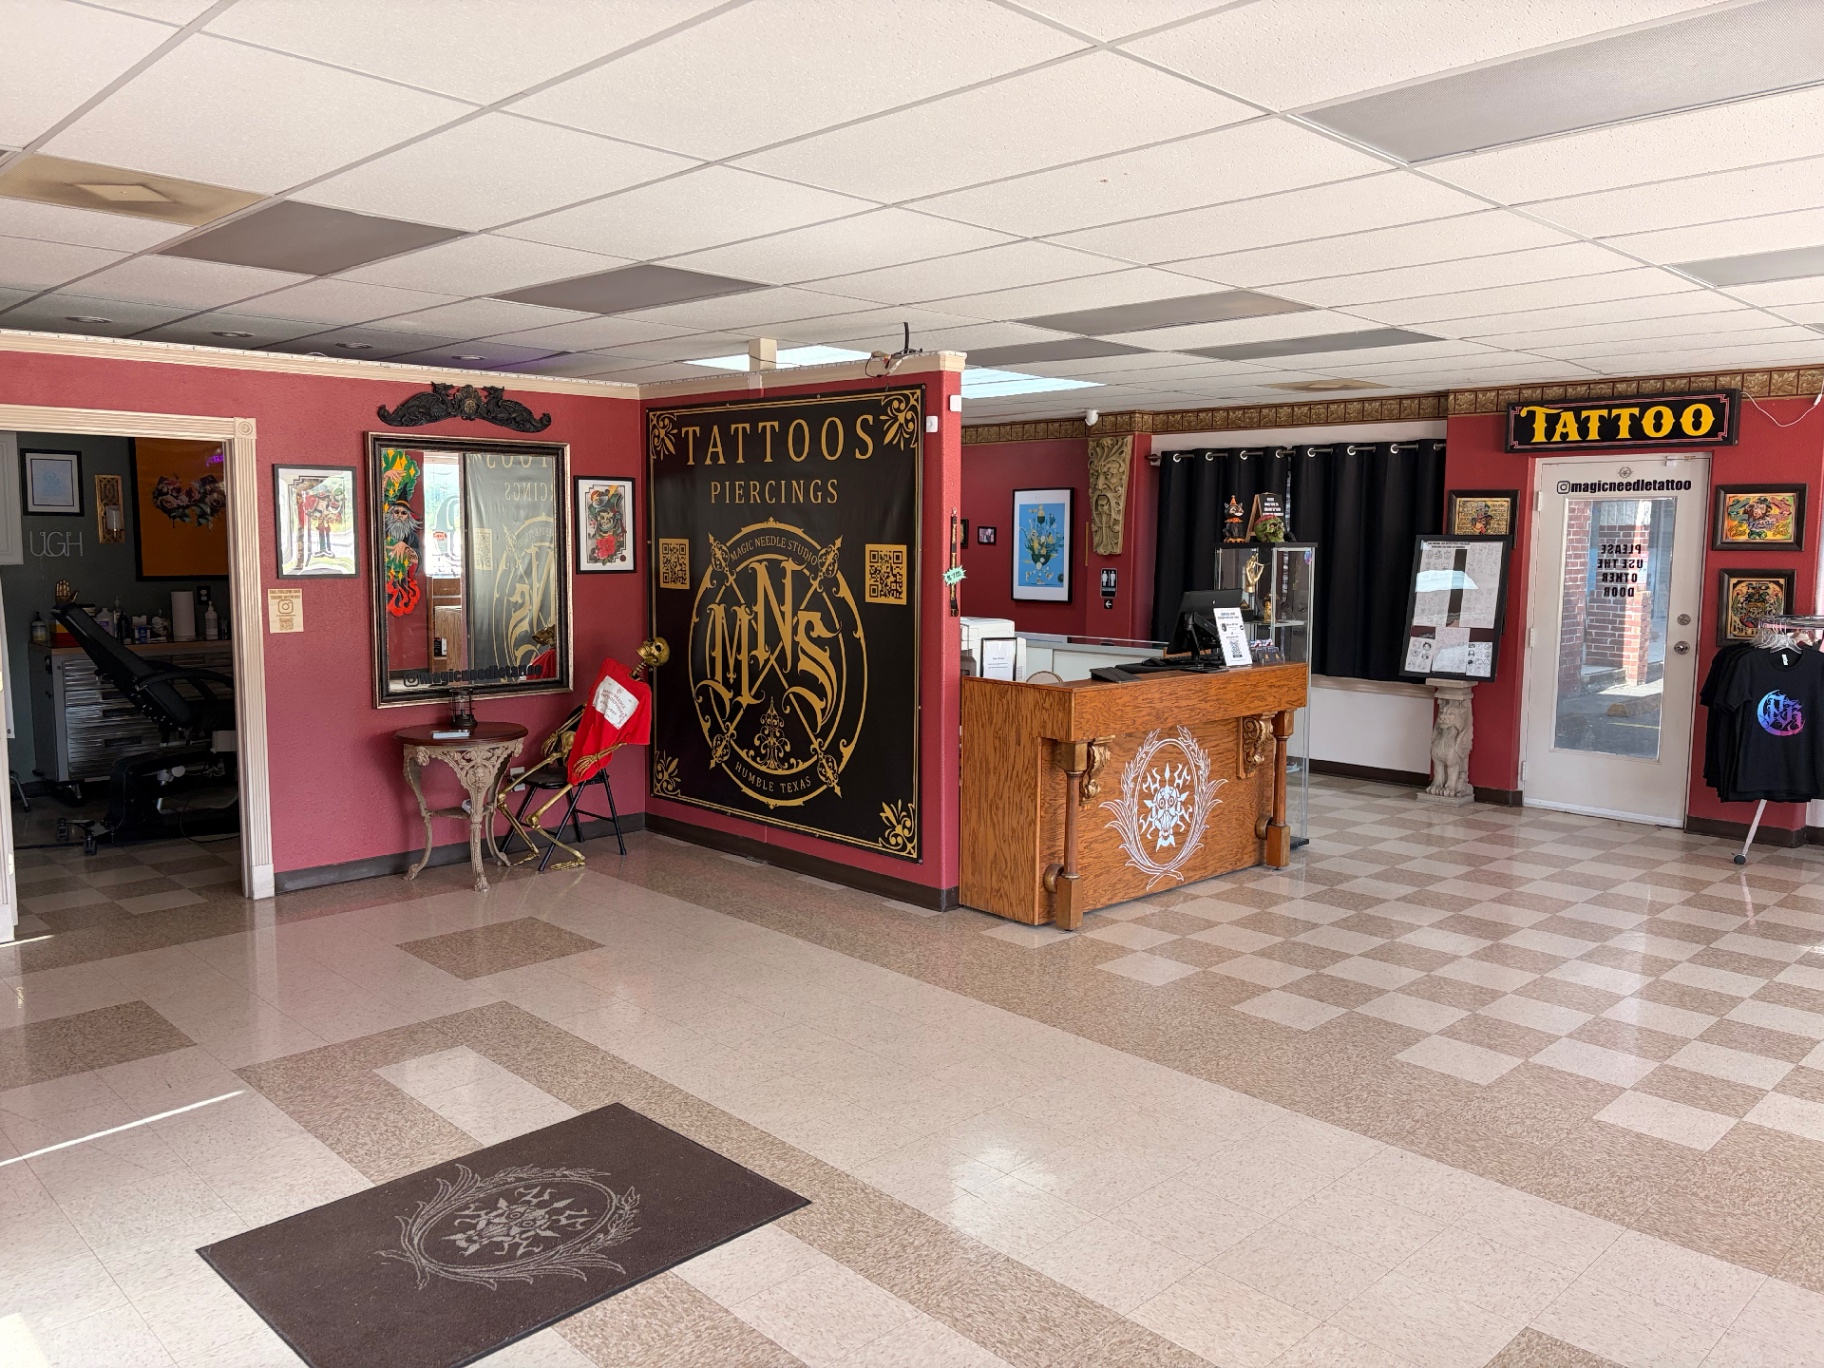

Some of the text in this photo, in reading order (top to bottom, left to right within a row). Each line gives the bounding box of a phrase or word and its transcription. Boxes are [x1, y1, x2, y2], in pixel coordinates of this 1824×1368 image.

[1519, 403, 1716, 443] TATTOO
[681, 414, 875, 466] TATTOOS
[710, 479, 839, 504] PIERCINGS
[1571, 479, 1692, 494] magicneedletattoo
[29, 530, 83, 558] UGH
[730, 536, 817, 566] MAGIC NEEDLE STUDIO
[734, 761, 812, 794] HUMBLE TEXAS
